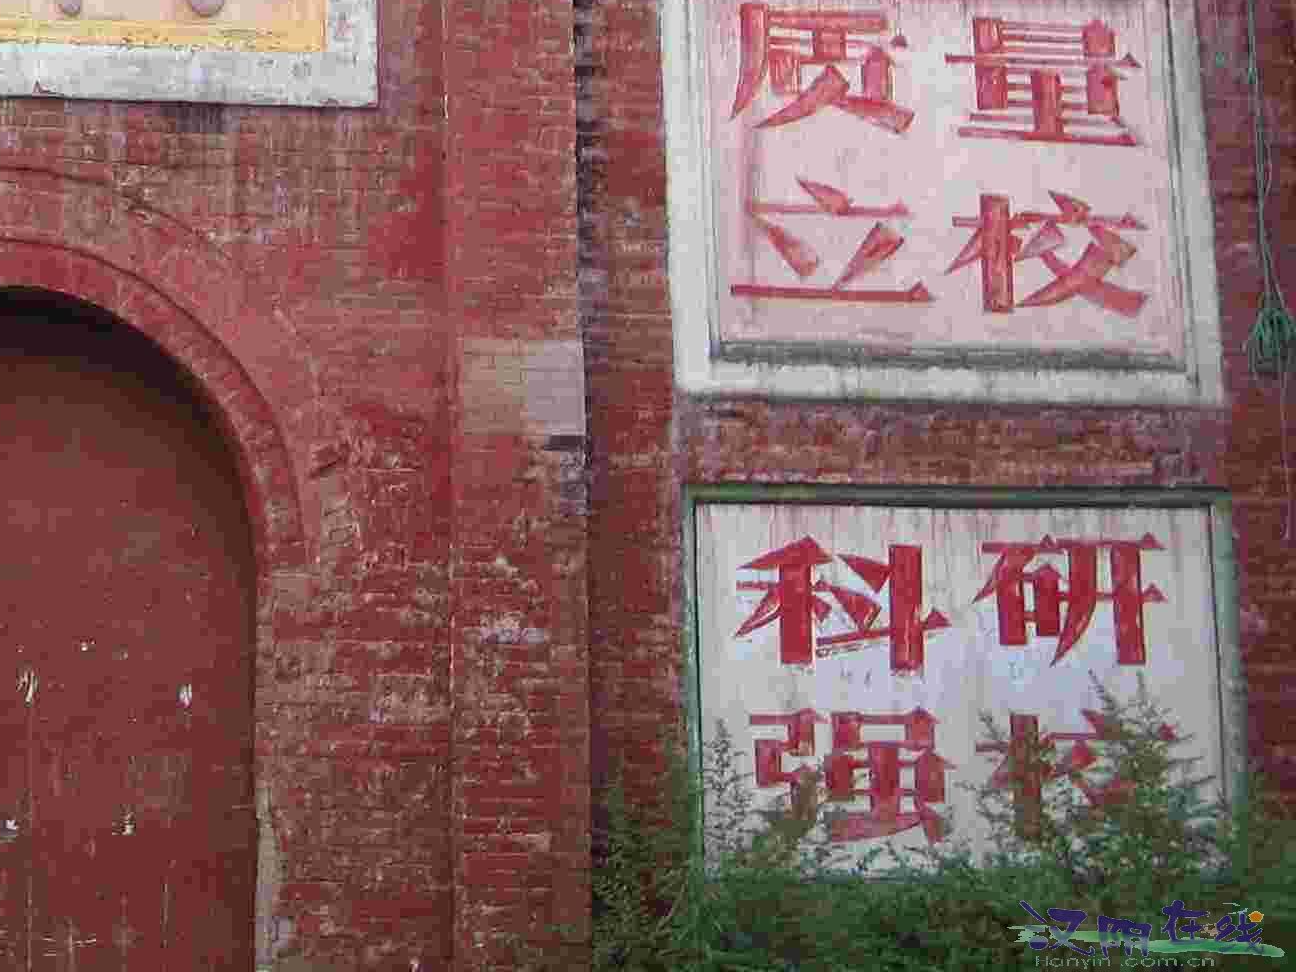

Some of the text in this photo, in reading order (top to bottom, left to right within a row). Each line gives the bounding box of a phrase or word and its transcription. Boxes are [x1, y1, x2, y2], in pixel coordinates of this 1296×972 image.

[730, 3, 1142, 146] 质量
[730, 176, 1147, 318] 立校
[734, 534, 1167, 676] 科研
